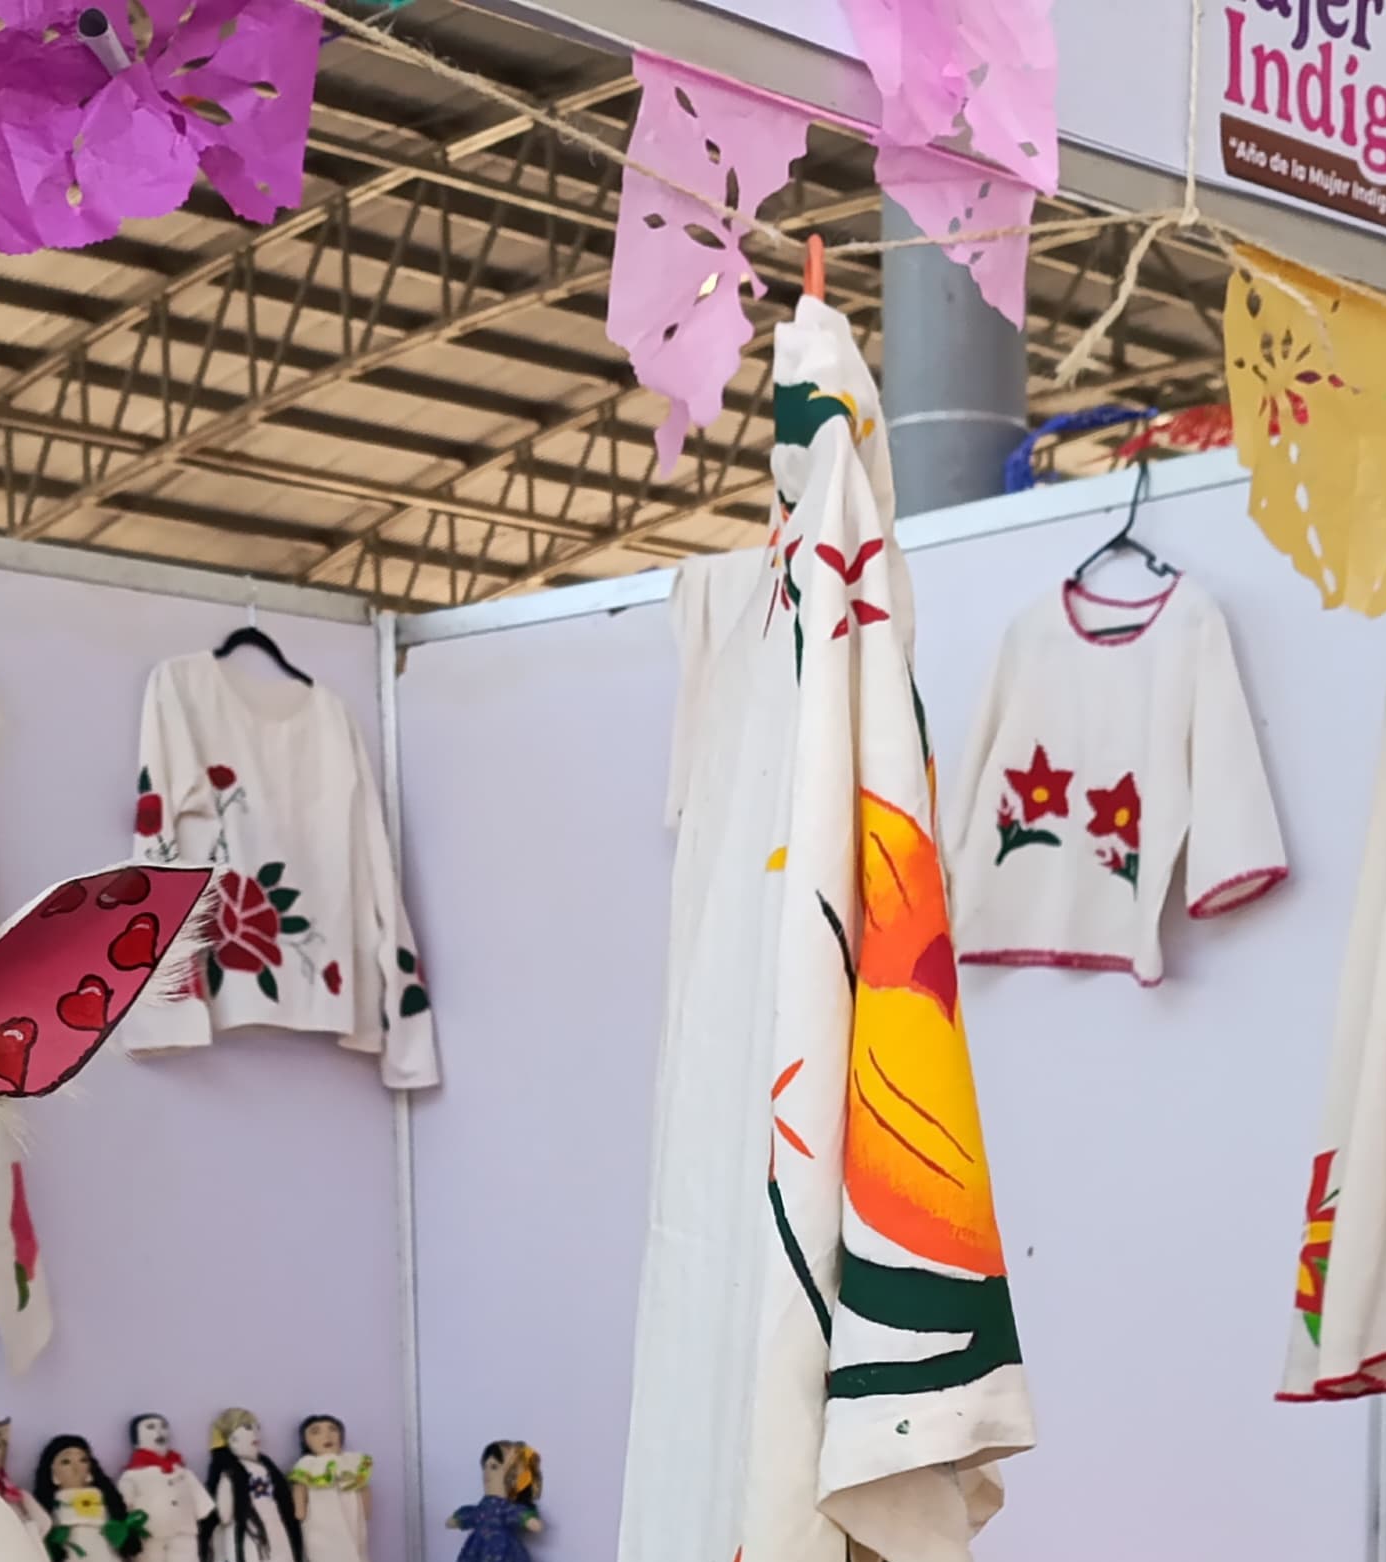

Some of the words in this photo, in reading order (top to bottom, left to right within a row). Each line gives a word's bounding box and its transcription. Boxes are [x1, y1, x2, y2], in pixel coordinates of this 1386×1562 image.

[1269, 152, 1289, 176] de
[1291, 159, 1307, 182] la
[1308, 165, 1351, 197] Mujer
